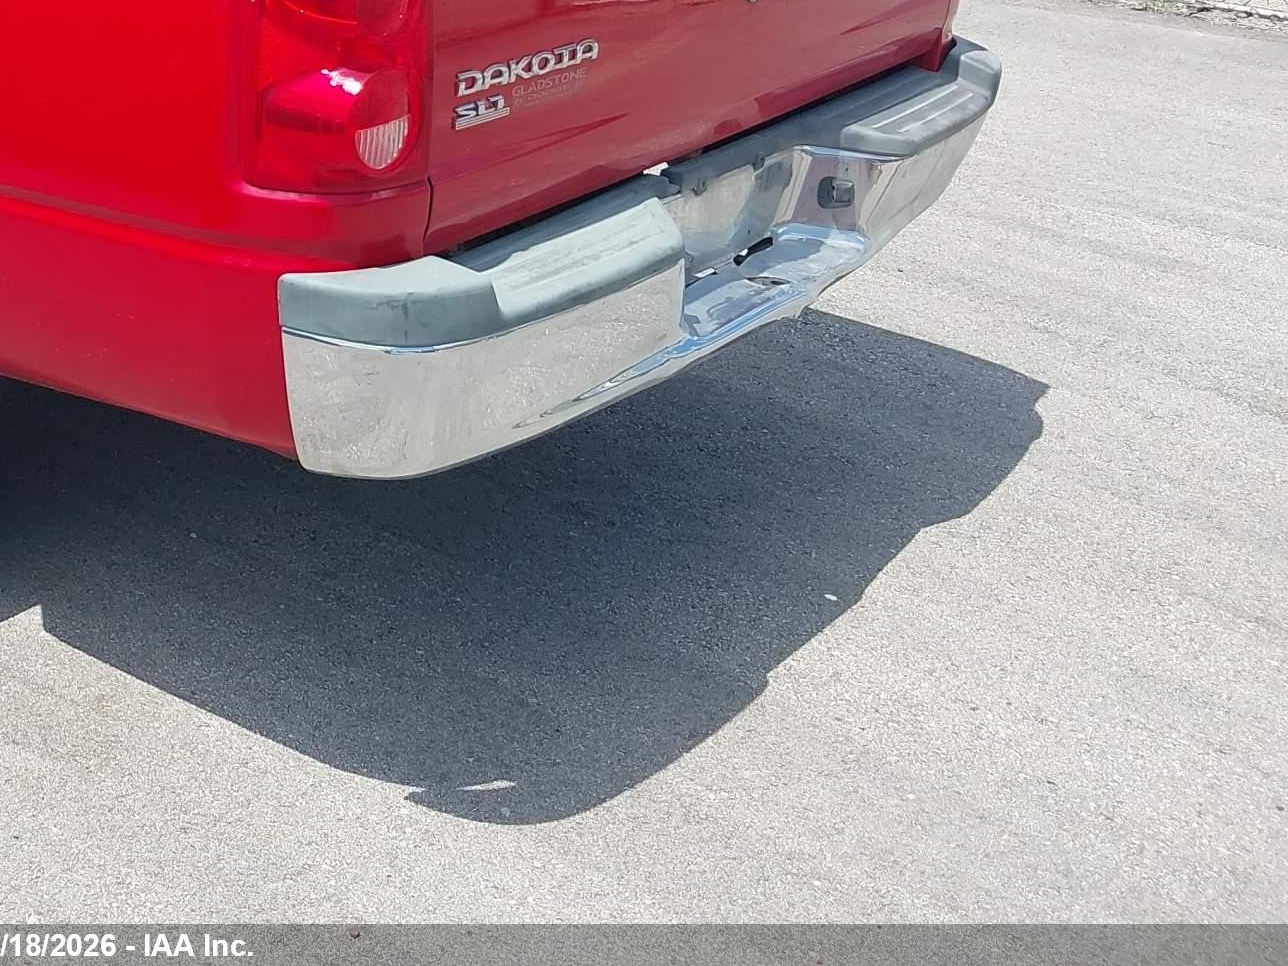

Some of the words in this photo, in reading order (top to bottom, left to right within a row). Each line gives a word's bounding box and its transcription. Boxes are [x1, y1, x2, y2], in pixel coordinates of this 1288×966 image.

[456, 37, 599, 97] DAKOTA
[512, 67, 587, 96] GLADSTONE
[454, 93, 505, 120] SLT
